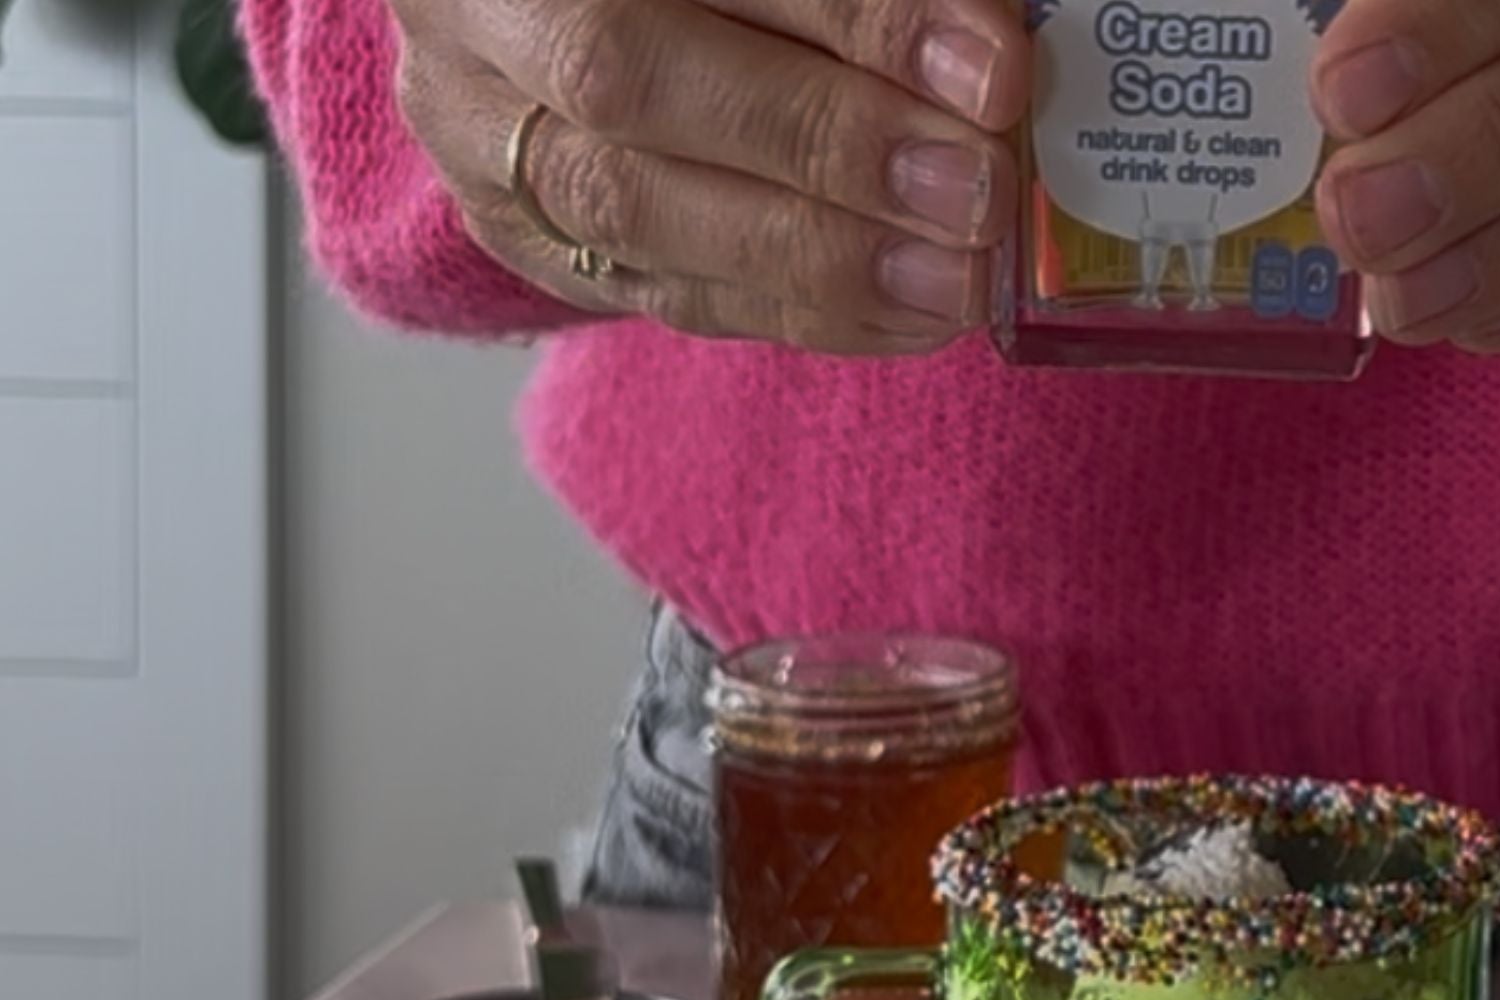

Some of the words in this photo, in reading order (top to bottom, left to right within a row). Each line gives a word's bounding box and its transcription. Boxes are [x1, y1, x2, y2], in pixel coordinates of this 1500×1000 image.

[1098, 3, 1270, 59] Cream
[1111, 61, 1252, 118] Soda
[1077, 128, 1176, 154] natural
[1184, 129, 1201, 153] &
[1208, 132, 1281, 157] clean
[1101, 157, 1169, 183] drink
[1177, 162, 1256, 192] drops
